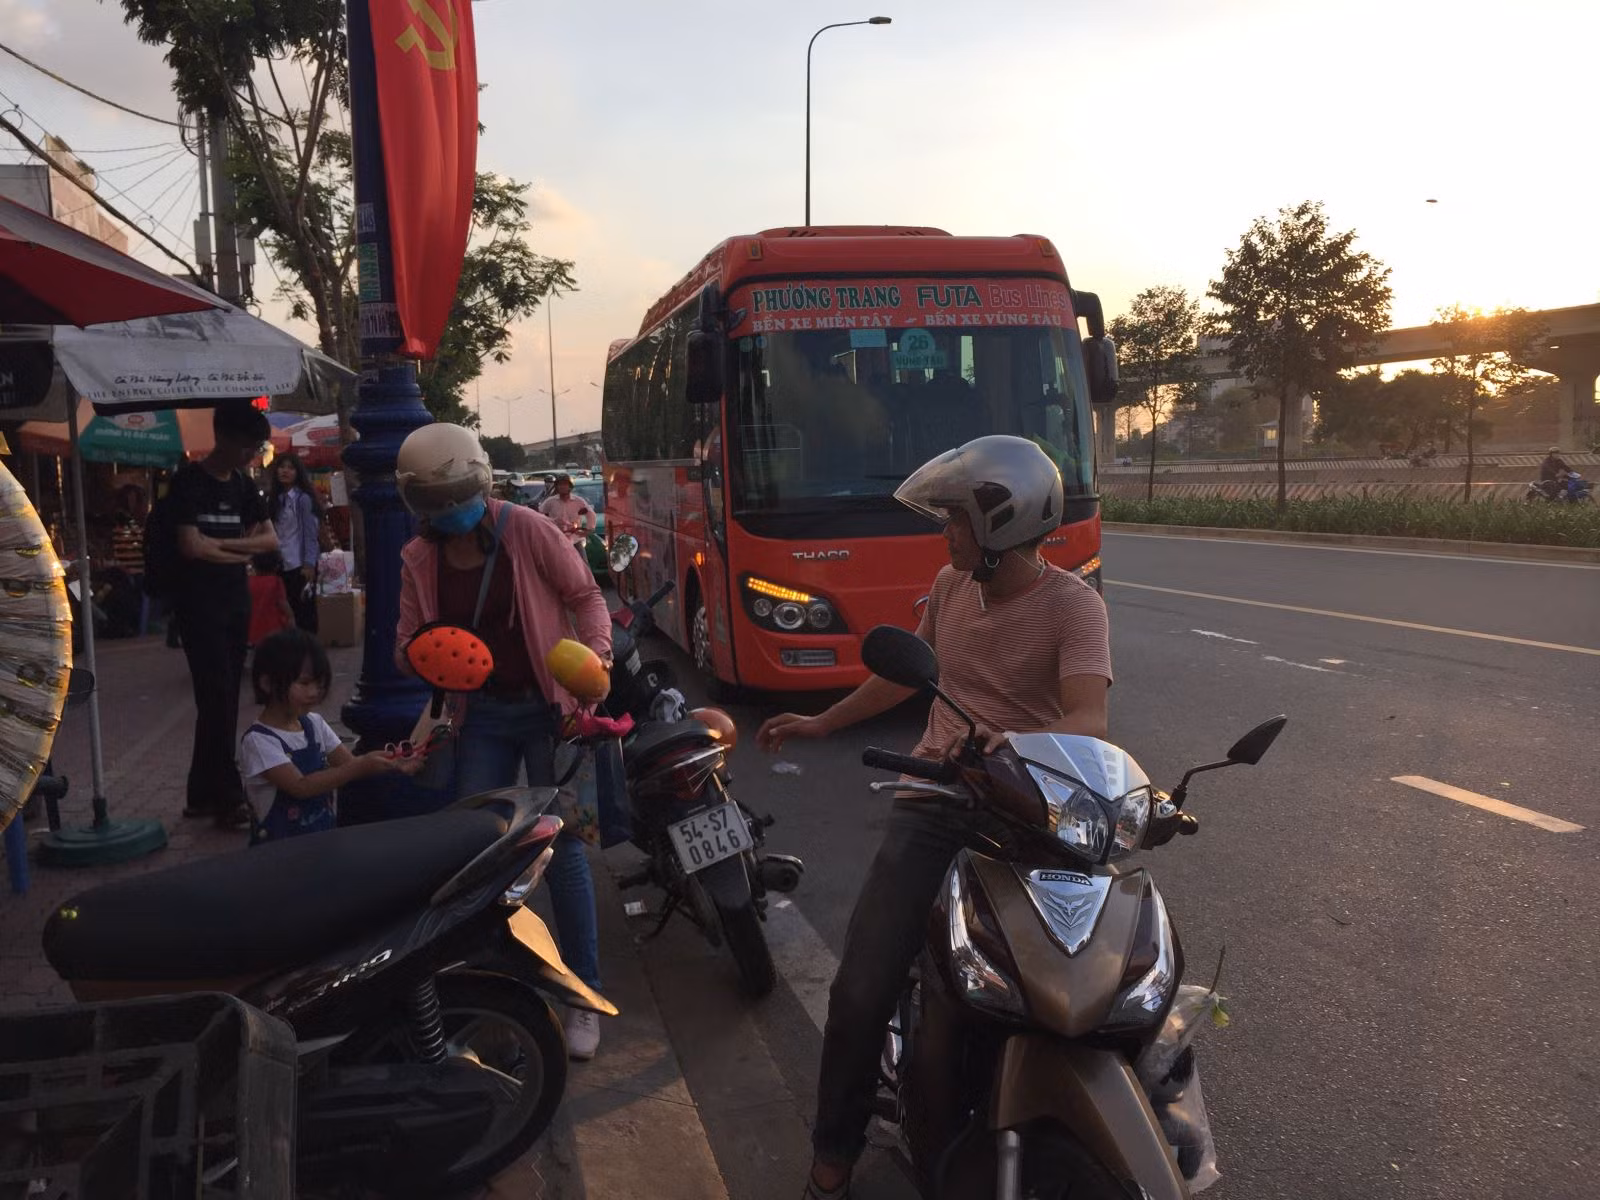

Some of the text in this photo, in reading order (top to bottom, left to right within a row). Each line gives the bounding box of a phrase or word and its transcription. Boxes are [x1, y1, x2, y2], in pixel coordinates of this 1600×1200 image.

[752, 283, 1068, 314] PHƯƠNG TRANG FUTA Bus Lines
[789, 316, 813, 330] XE
[859, 313, 893, 328] TÂY
[924, 310, 957, 327] BẾN
[959, 314, 982, 326] XE
[983, 310, 1029, 326] VŨNG
[908, 334, 929, 350] 26
[224, 383, 269, 394] CHANGES
[791, 549, 850, 561] THACO
[688, 829, 741, 865] 0846
[1041, 873, 1090, 885] HONDA
